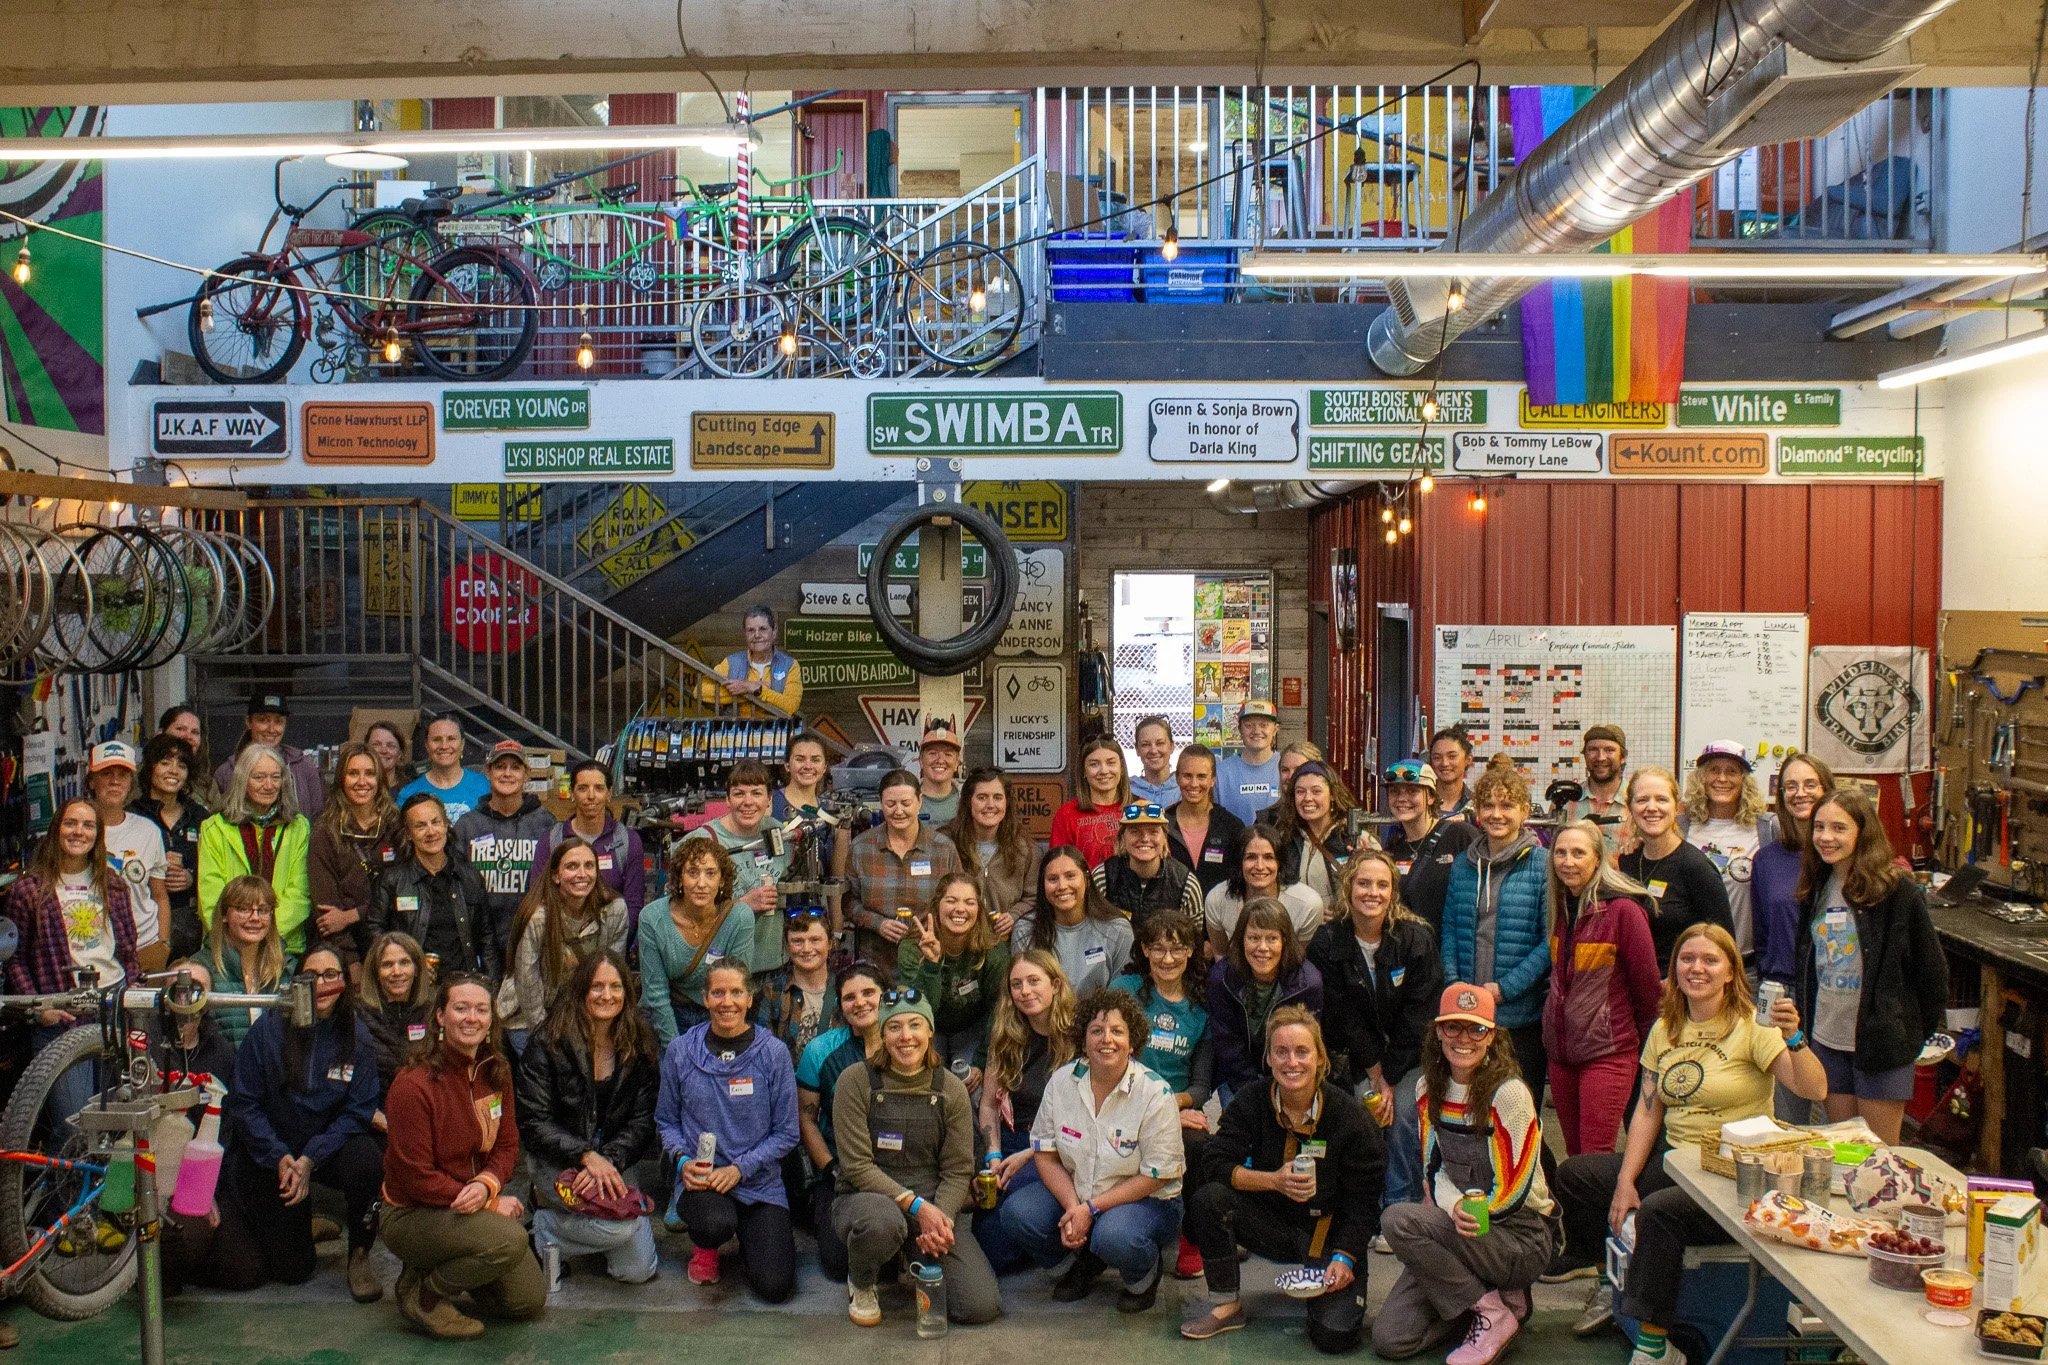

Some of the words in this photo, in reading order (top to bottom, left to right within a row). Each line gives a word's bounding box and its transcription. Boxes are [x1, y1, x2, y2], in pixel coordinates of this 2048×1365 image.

[1324, 391, 1369, 407] SOUTH
[1371, 391, 1410, 407] BOISE
[445, 398, 510, 419] FOREVER
[515, 396, 569, 417] YOUNG
[571, 400, 586, 414] DR
[1154, 403, 1193, 416] Glenn
[1196, 404, 1208, 416] &
[1211, 403, 1248, 419] Sonja
[1252, 404, 1293, 416] Brown
[1324, 406, 1422, 423] CORRECTIONAL
[1424, 407, 1473, 423] ENTER
[1529, 403, 1568, 419] CALL
[1574, 402, 1661, 419] ENGINEERS
[1682, 396, 1708, 406] Steve
[1712, 394, 1787, 422] White
[1794, 394, 1802, 404] &
[1805, 394, 1834, 407] Family
[225, 418, 266, 436] WAY
[309, 413, 343, 426] Crone
[345, 413, 403, 426] Hawxhurst
[405, 413, 427, 426] LLP
[697, 417, 757, 436] Cutting
[762, 417, 801, 435] Edge
[874, 427, 899, 443] SW
[904, 402, 1087, 443] SWIMBA
[1090, 428, 1112, 443] TR
[1187, 422, 1199, 436] in
[1202, 422, 1240, 436] honor
[1243, 422, 1259, 436] of
[317, 437, 353, 448] Micron
[357, 437, 418, 450] Technology
[697, 441, 781, 459] Landscape
[1189, 441, 1224, 455] Darla
[1227, 441, 1257, 457] King
[1462, 436, 1486, 448] Bob
[1490, 436, 1499, 448] &
[1503, 437, 1547, 451] Tommy
[1551, 437, 1593, 449] LeBow
[507, 448, 532, 467] LYSI
[536, 447, 585, 466] BISHOP
[589, 446, 622, 465] REAL
[625, 445, 671, 465] ESTATE
[1311, 442, 1387, 463] SHIFTING
[1390, 443, 1444, 463] GEARS
[1640, 442, 1762, 464] Kount.com
[1782, 446, 1842, 463] Diamond
[1856, 446, 1923, 467] Recycling
[1486, 454, 1533, 468] Memory
[1538, 454, 1568, 466] Lane
[460, 490, 489, 505] JIMMY
[969, 501, 1059, 529] NSER
[894, 552, 907, 569] &
[805, 592, 837, 606] Steve
[842, 592, 851, 606] &
[889, 592, 907, 602] Lane
[1012, 601, 1053, 613] LANCY
[1019, 619, 1053, 631] ANNE
[1764, 619, 1796, 630] LUNCH
[787, 629, 803, 637] Kurt
[805, 630, 844, 643] Holzer
[847, 630, 873, 643] Bike
[997, 637, 1061, 649] ANDERSON
[1486, 629, 1527, 648] APRIL
[898, 663, 909, 677] LN
[882, 709, 921, 726] HAY
[1010, 715, 1049, 724] LUCKY'S
[1003, 731, 1056, 740] FRIENDSHIP
[1018, 747, 1041, 756] LANE
[1017, 787, 1045, 802] REL
[1016, 803, 1052, 817] WING
[480, 869, 529, 893] VALLEY
